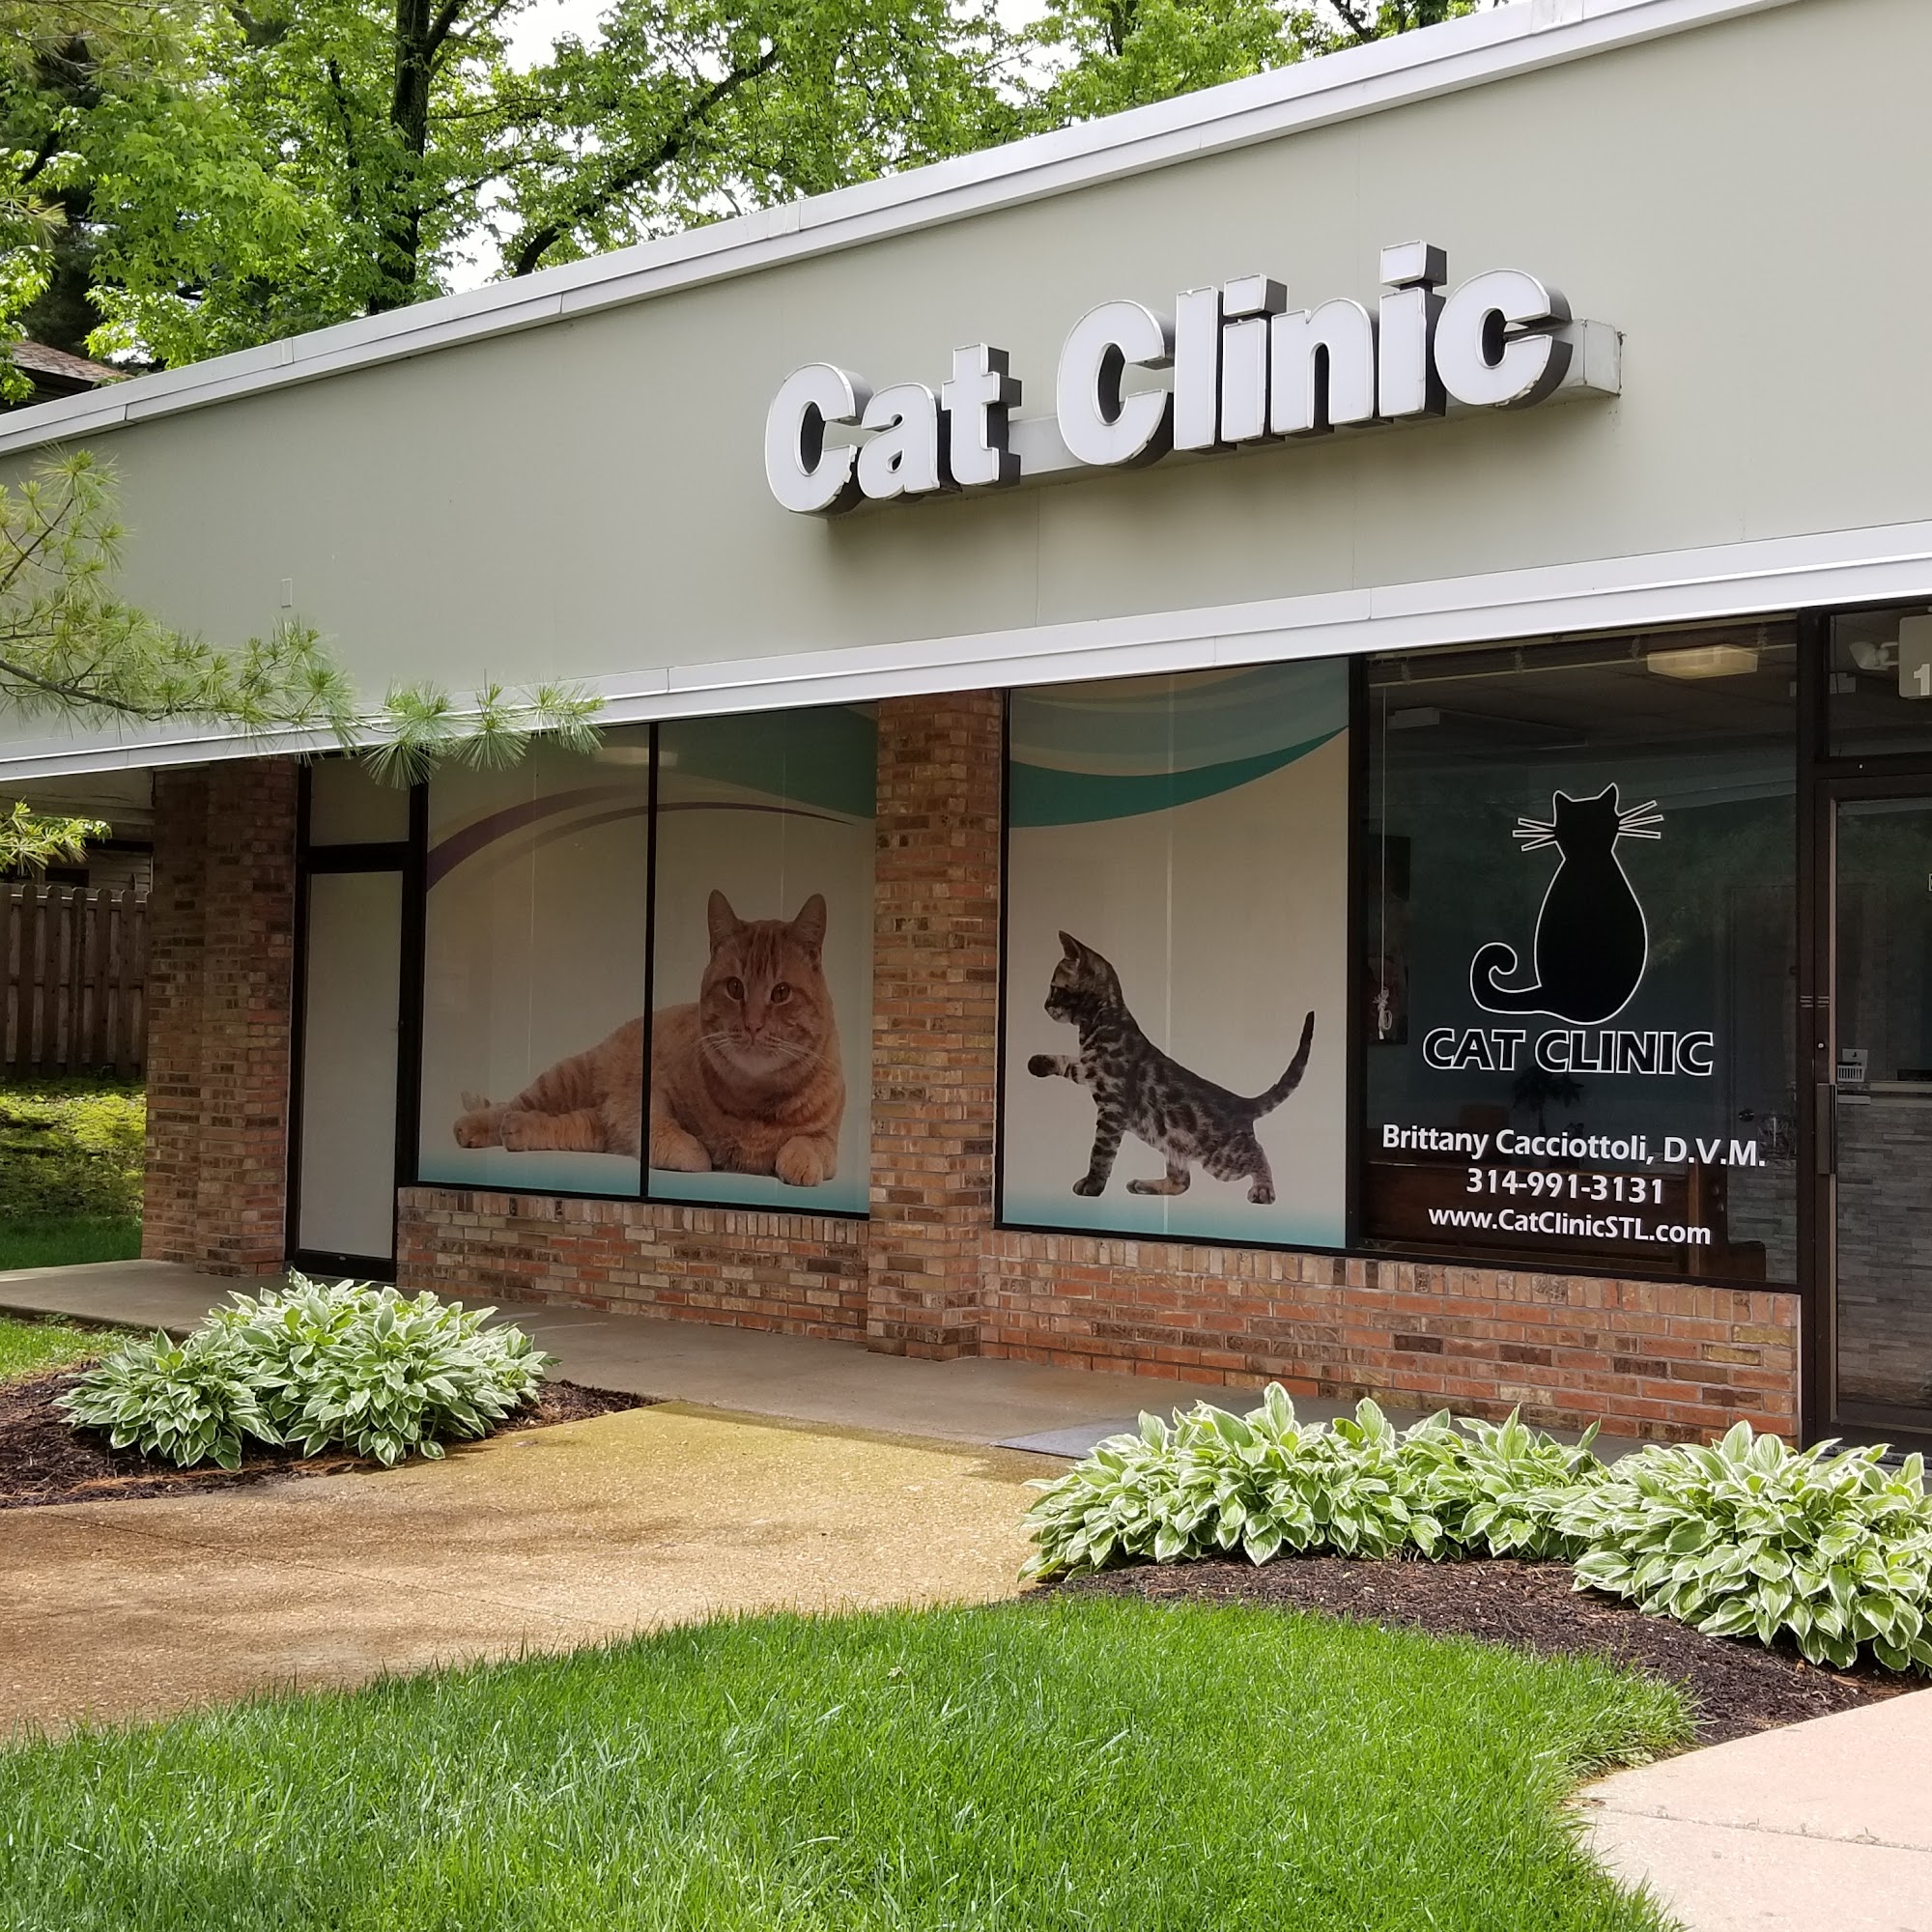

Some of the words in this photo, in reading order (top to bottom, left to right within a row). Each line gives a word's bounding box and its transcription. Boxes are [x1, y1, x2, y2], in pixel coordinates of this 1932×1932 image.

[764, 342, 1023, 519] Cat
[1056, 241, 1573, 469] Clinic
[1423, 1028, 1525, 1070] CAT
[1534, 1031, 1714, 1076] CLINIC
[1382, 1123, 1489, 1159] Brittany
[1495, 1128, 1654, 1165] Cacciottoli,
[1663, 1138, 1766, 1166] D.V.M.
[1465, 1168, 1662, 1204] 314-991-3131
[1429, 1208, 1711, 1244] www.CatClinicSTL.com
